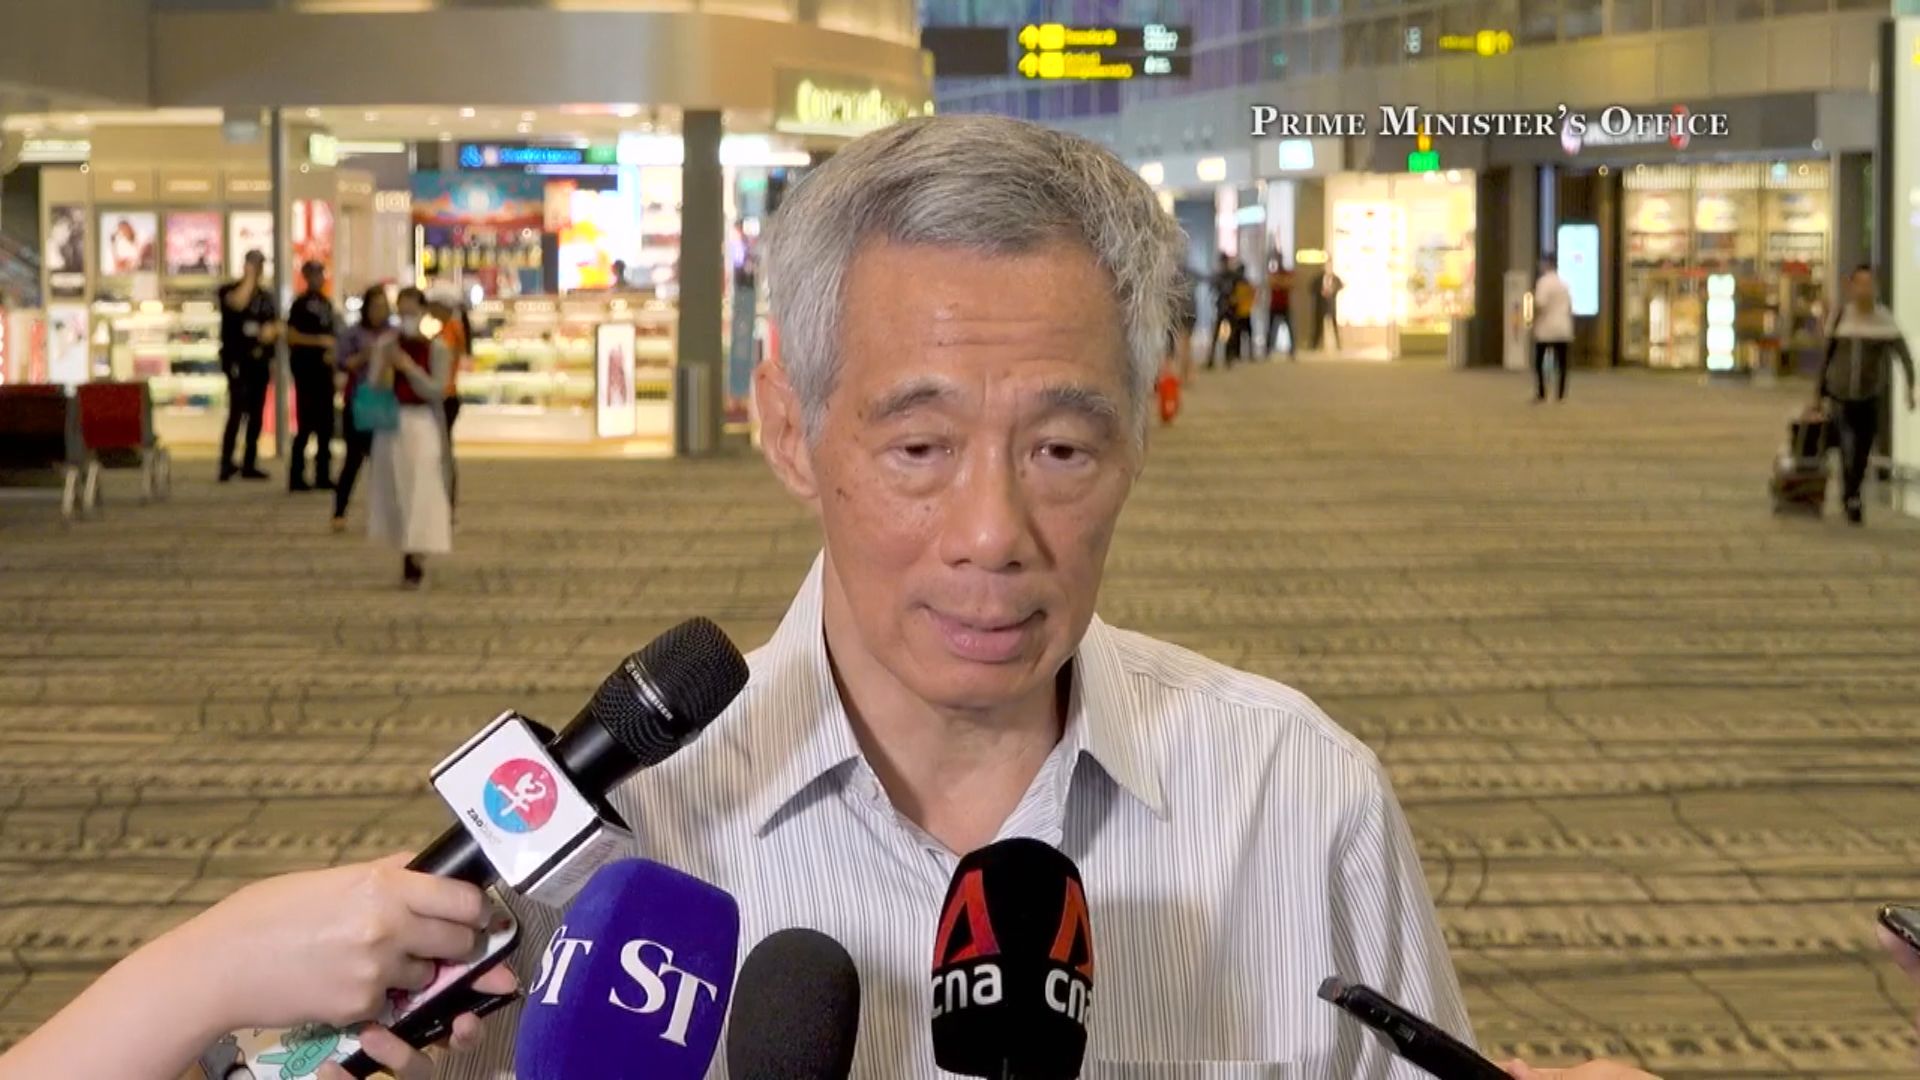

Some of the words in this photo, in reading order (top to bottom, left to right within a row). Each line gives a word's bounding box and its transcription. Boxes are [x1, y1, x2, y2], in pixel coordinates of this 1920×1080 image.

[529, 925, 593, 1005] ST
[608, 938, 718, 1047] ST
[931, 963, 1003, 1020] cna
